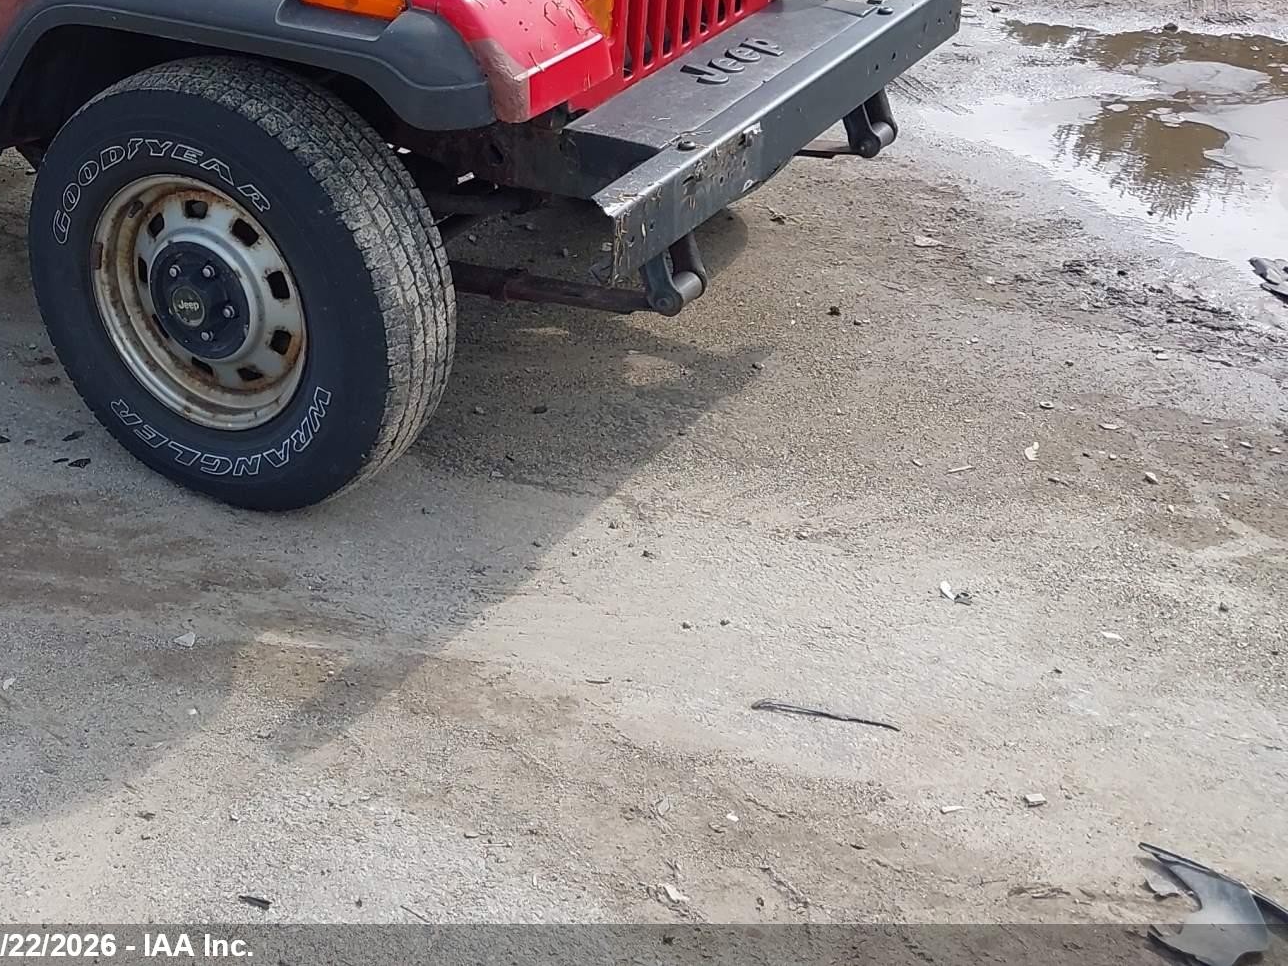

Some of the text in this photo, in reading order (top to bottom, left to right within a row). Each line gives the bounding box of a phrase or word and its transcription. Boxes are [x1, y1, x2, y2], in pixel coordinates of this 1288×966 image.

[680, 37, 785, 85] Jeep
[52, 137, 272, 245] GOODYEAR
[177, 299, 200, 312] Jeep
[110, 386, 333, 477] WRANGLER
